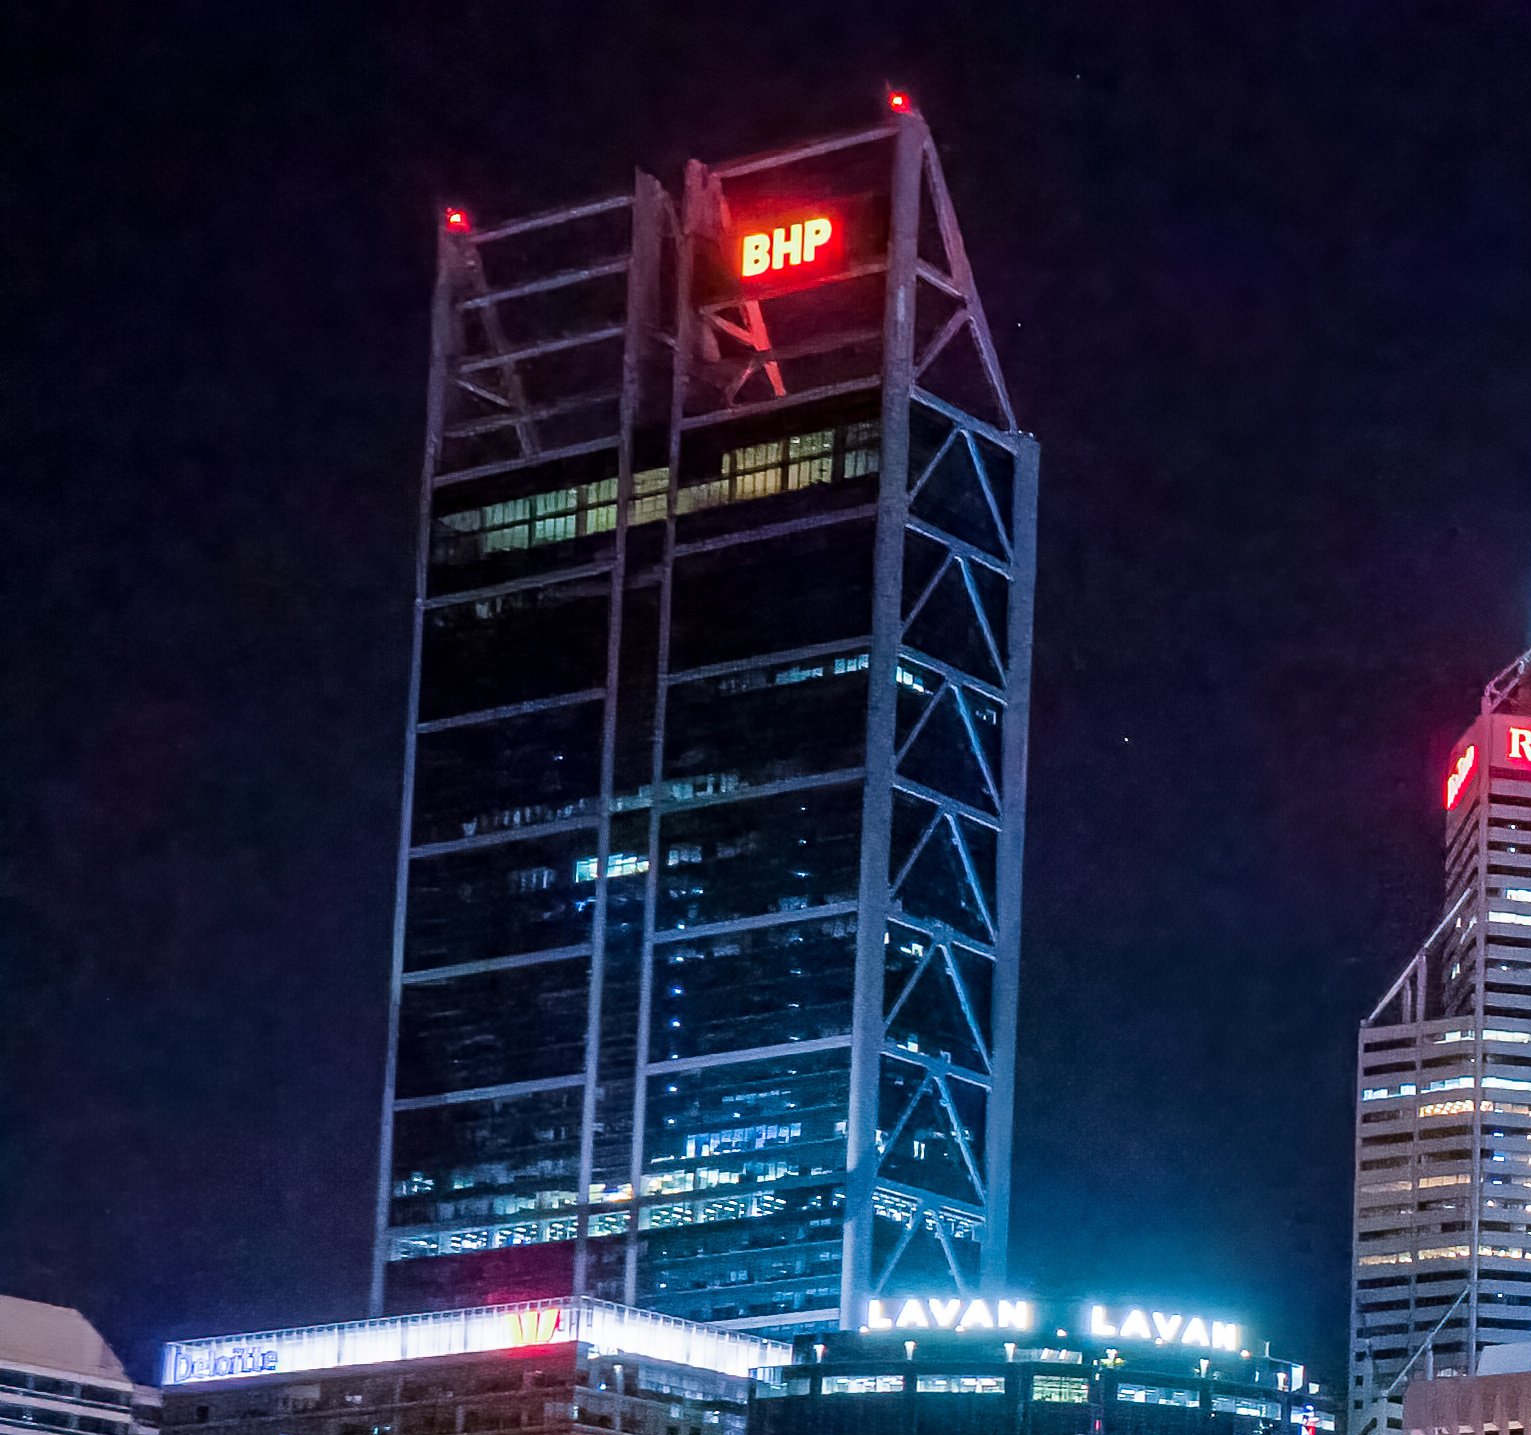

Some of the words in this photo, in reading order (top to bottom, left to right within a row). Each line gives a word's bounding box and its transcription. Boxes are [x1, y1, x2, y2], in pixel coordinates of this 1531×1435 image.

[742, 217, 832, 277] BHP
[868, 1298, 1029, 1330] LAVAN
[1091, 1305, 1237, 1351] LAVAN
[173, 1344, 279, 1383] Deloitte
